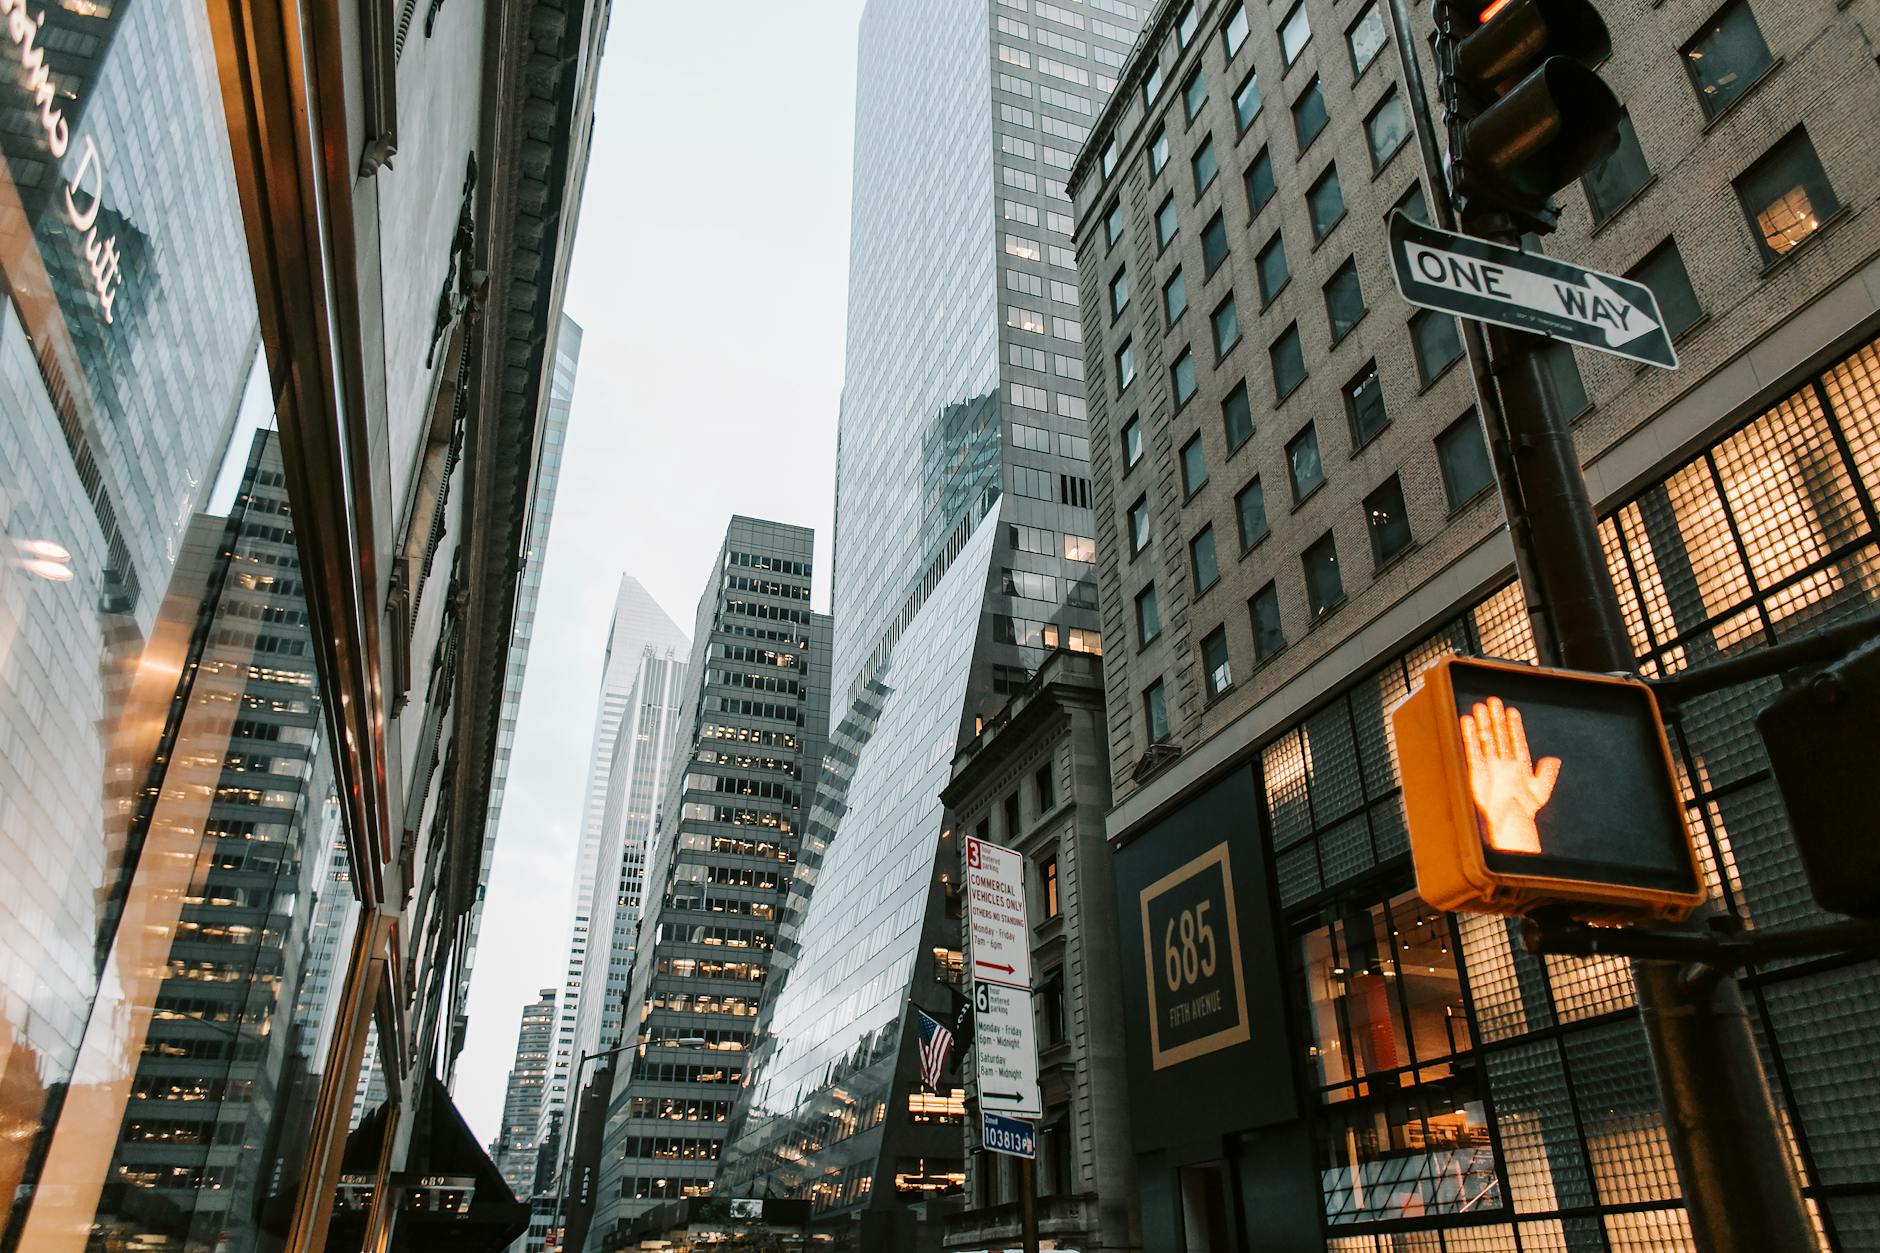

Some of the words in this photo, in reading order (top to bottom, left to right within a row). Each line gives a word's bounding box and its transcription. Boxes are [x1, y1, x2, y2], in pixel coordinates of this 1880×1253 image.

[65, 134, 121, 325] Dutti
[1417, 251, 1512, 299] ONE
[1554, 283, 1631, 331] WAY
[969, 841, 979, 866] 3
[971, 874, 1015, 896] COMMERCIAL
[971, 888, 1004, 908] VEHICLES
[1006, 898, 1023, 913] ONLY
[972, 907, 992, 920] OTHERS
[992, 913, 1001, 922] NO
[1001, 915, 1024, 928] STANDING
[973, 923, 995, 939] Monday
[999, 929, 1016, 943] Friday
[974, 935, 986, 946] 7am
[990, 939, 1003, 950] 6pm
[1165, 899, 1217, 992] 685
[976, 985, 988, 1011] 6
[1169, 1003, 1190, 1028] FIFTH
[1192, 989, 1222, 1019] AVENUE
[990, 1005, 1009, 1016] parking
[978, 1022, 1001, 1036] Monday
[1005, 1025, 1022, 1038] Friday
[979, 1034, 992, 1047] 6pm
[997, 1035, 1020, 1049] Midnight
[980, 1052, 1006, 1067] Saturday
[980, 1065, 993, 1076] 8am
[998, 1067, 1022, 1081] Midnight
[985, 1126, 1021, 1151] 103813
[420, 1176, 445, 1186] 689
